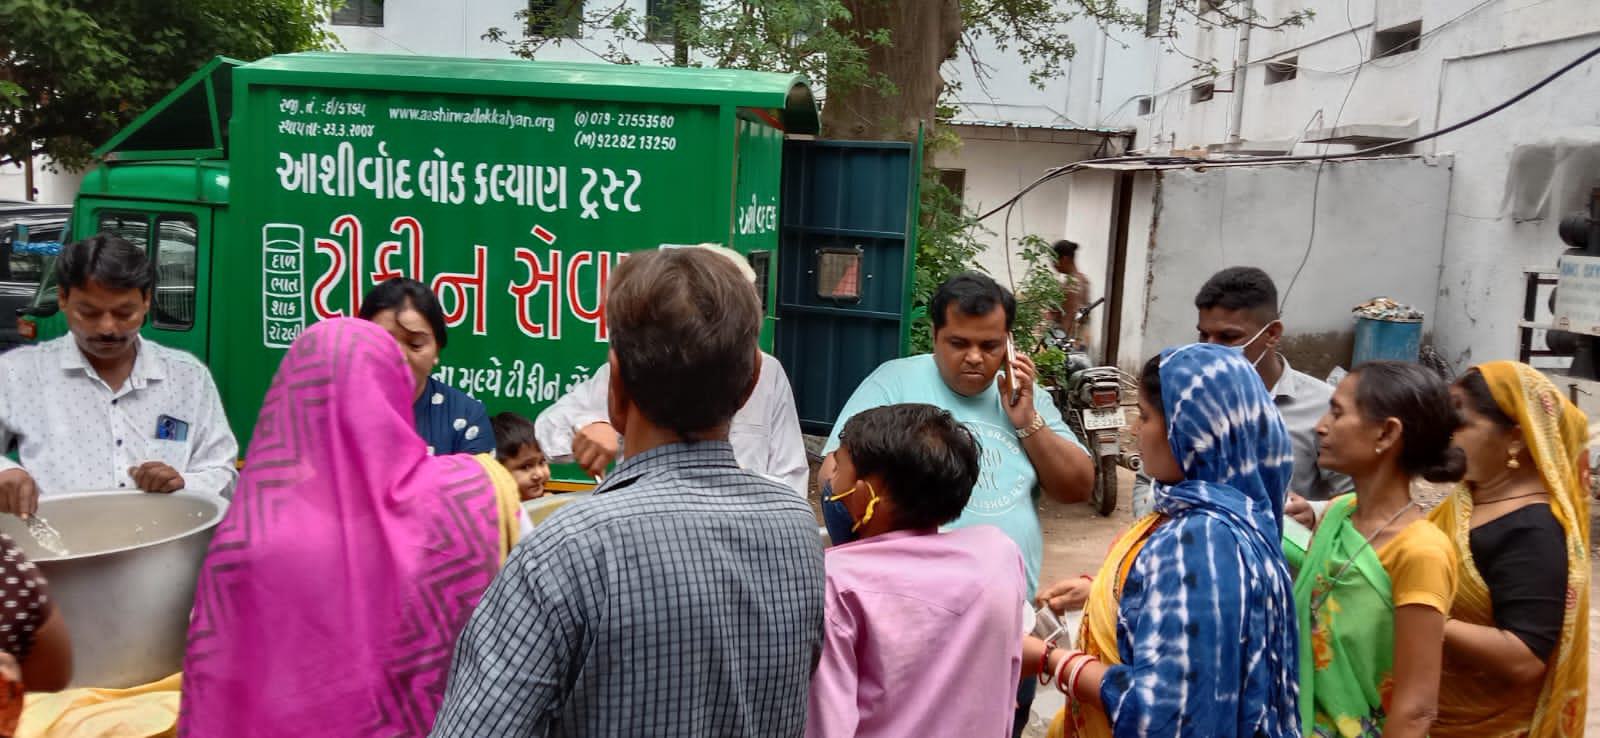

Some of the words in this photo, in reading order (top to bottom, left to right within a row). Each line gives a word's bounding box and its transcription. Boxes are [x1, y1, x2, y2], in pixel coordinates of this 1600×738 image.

[389, 106, 555, 132] www.aashirwadlokkalyan.org
[639, 135, 677, 151] 13250
[275, 140, 415, 200] આશીર્વાદ
[417, 147, 467, 205] લોક
[473, 162, 568, 213] કલ્યાણ
[579, 167, 643, 220] ટ્રસ્ટ
[271, 278, 299, 293] ભાત
[507, 223, 631, 343] સેવ
[271, 300, 296, 316] શાક
